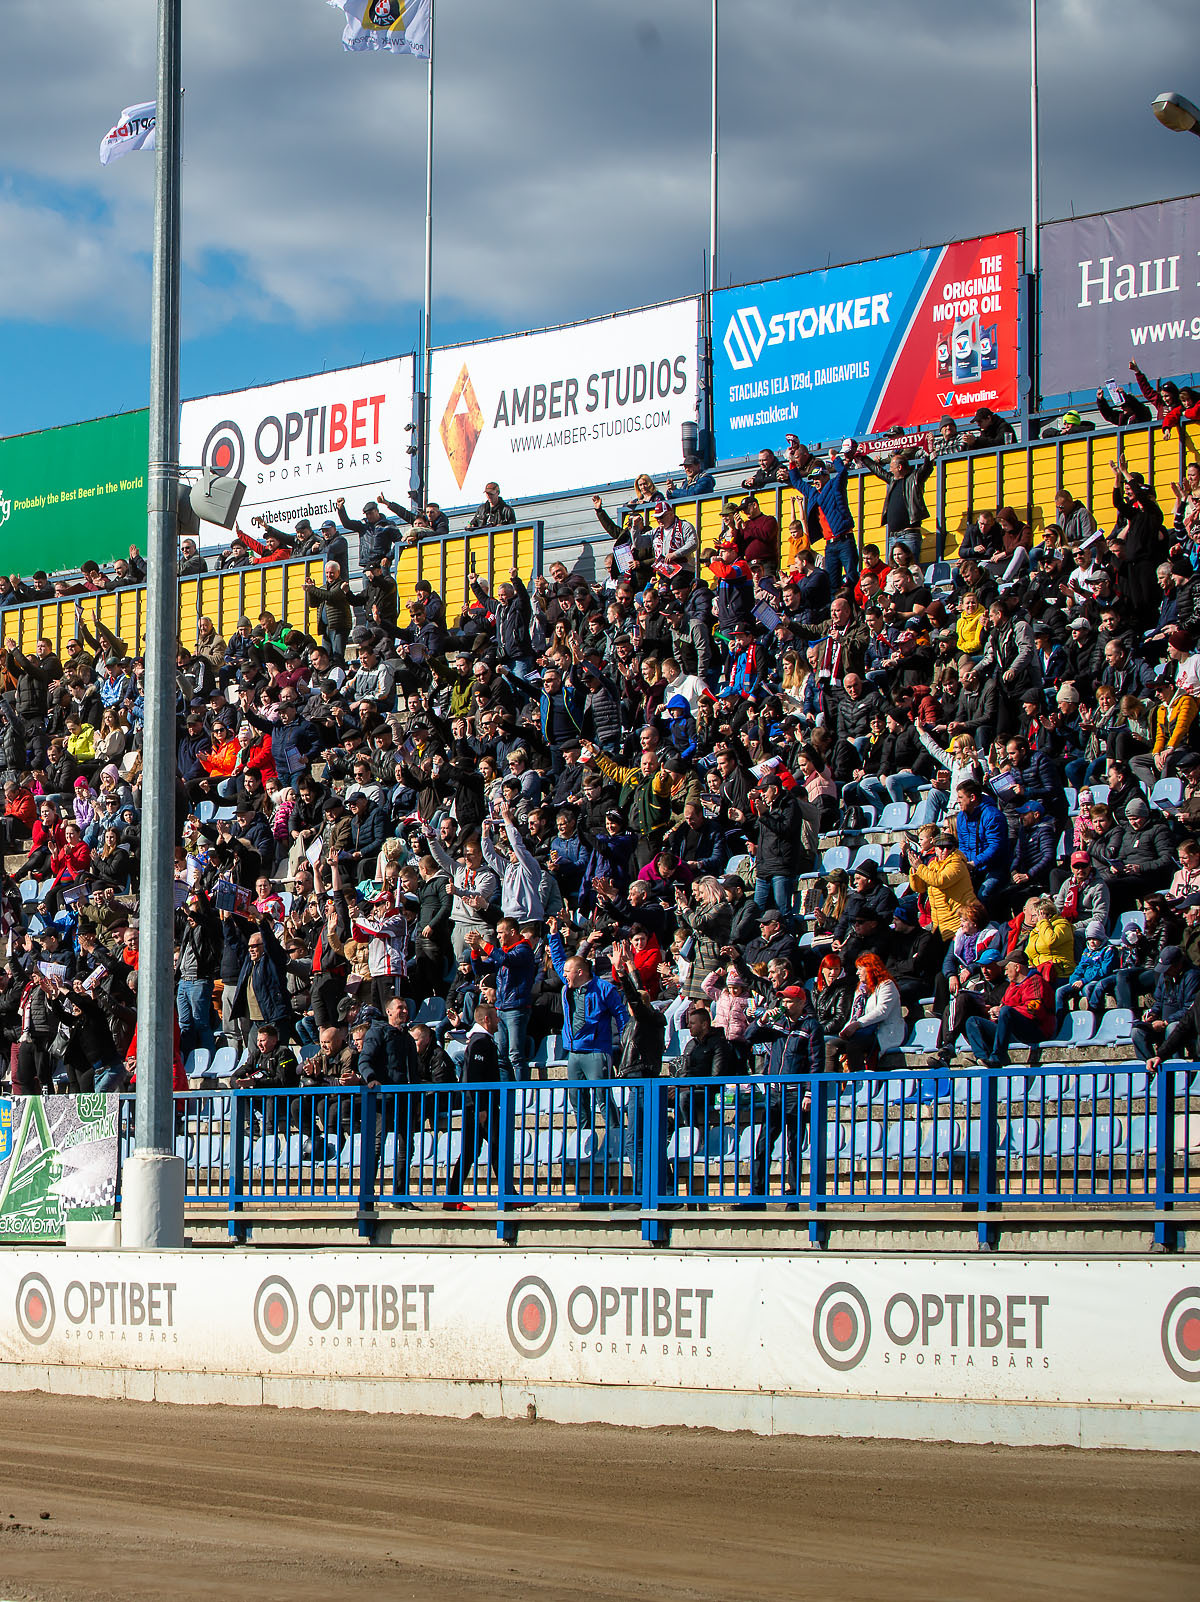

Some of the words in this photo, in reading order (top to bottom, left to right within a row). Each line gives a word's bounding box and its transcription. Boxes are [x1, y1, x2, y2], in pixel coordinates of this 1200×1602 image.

[980, 255, 1002, 275] THE
[1077, 255, 1180, 308] Наш
[943, 275, 1002, 301] ORIGINAL
[768, 294, 891, 346] STOKKER
[932, 300, 979, 322] MOTOR
[981, 294, 1002, 314] OIL
[493, 376, 580, 429] AMBER
[586, 355, 687, 412] STUDIOS
[729, 380, 769, 402] STACIJAS
[771, 376, 790, 395] IELA
[791, 371, 814, 391] 129d,
[815, 361, 870, 386] DAUGAVPILS
[254, 393, 386, 466] OPTIBET
[510, 410, 671, 454] WWW.AMBER-STUDIOS.COM
[729, 402, 799, 430] www.stokker.lv
[868, 433, 925, 450] LOKOMOTIV
[257, 462, 325, 484] SPORTA
[336, 450, 384, 471] BĀRS
[13, 495, 46, 511] Probably
[47, 492, 59, 505] the
[60, 490, 77, 502] Best
[78, 487, 96, 499] Beer
[96, 484, 104, 496] in
[105, 482, 118, 493] the
[119, 476, 144, 491] World
[92, 1112, 116, 1140] TRACK
[64, 1280, 177, 1327] OPTIBET
[308, 1283, 435, 1332] OPTIBET
[567, 1285, 714, 1340] OPTIBET
[65, 1329, 127, 1342] SPORTA
[138, 1329, 179, 1343] BĀRS
[883, 1292, 1050, 1350] OPTIBET
[308, 1336, 379, 1348] SPORTA
[390, 1334, 437, 1349] BĀRS
[568, 1341, 648, 1355] SPORTA
[662, 1342, 713, 1358] BĀRS
[884, 1351, 975, 1367] SPORTA
[991, 1352, 1050, 1369] BĀRS
